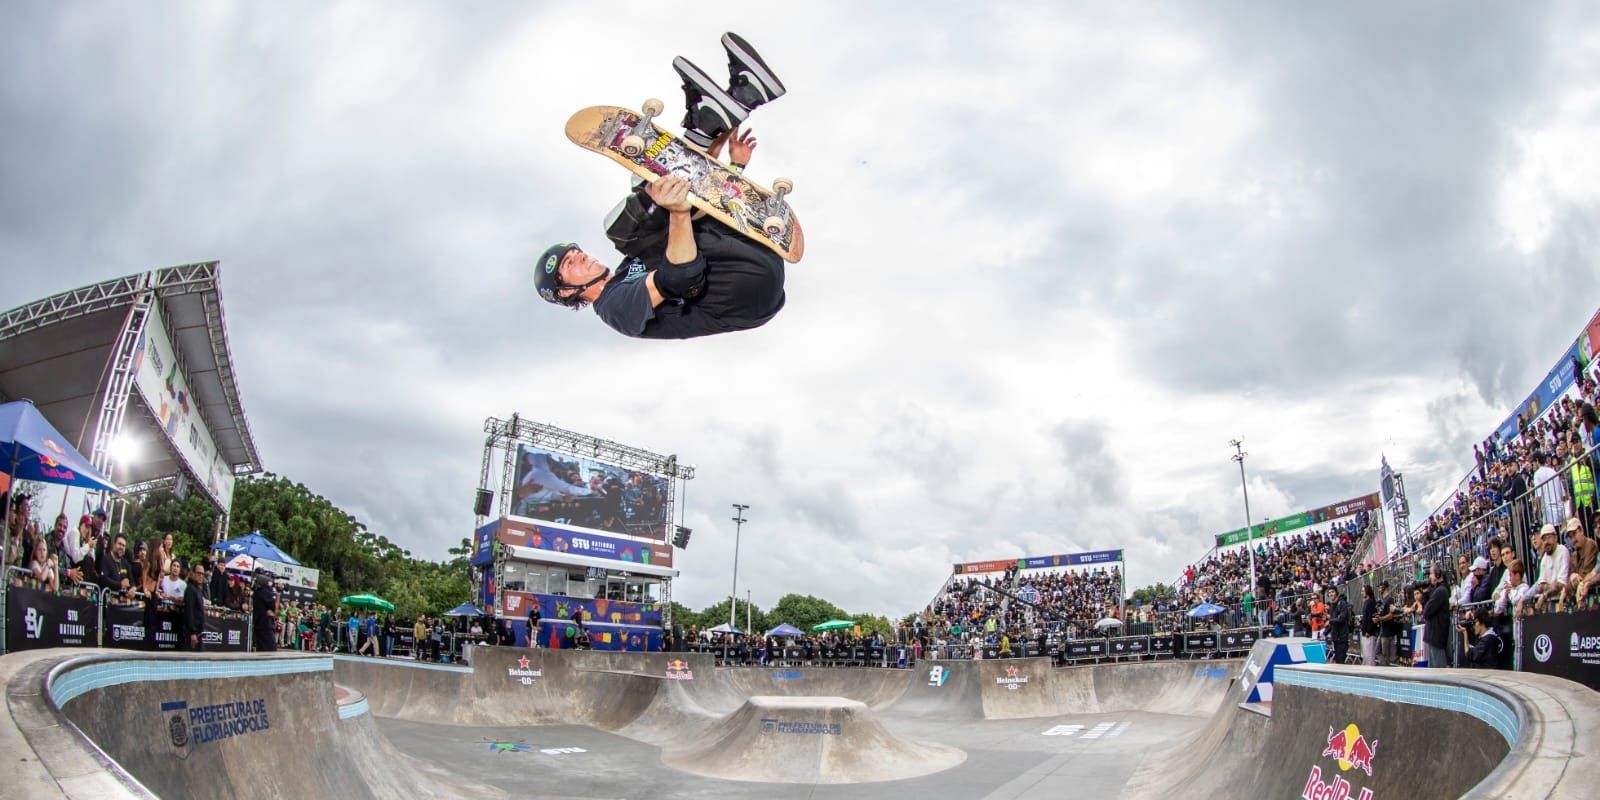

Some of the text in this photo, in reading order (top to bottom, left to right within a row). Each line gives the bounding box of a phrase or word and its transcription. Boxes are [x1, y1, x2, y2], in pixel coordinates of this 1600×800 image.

[572, 537, 590, 550] STU
[67, 610, 79, 621] STU
[508, 667, 542, 677] Heineken
[996, 675, 1029, 685] Heineken
[188, 698, 266, 726] PREFEITURA DE
